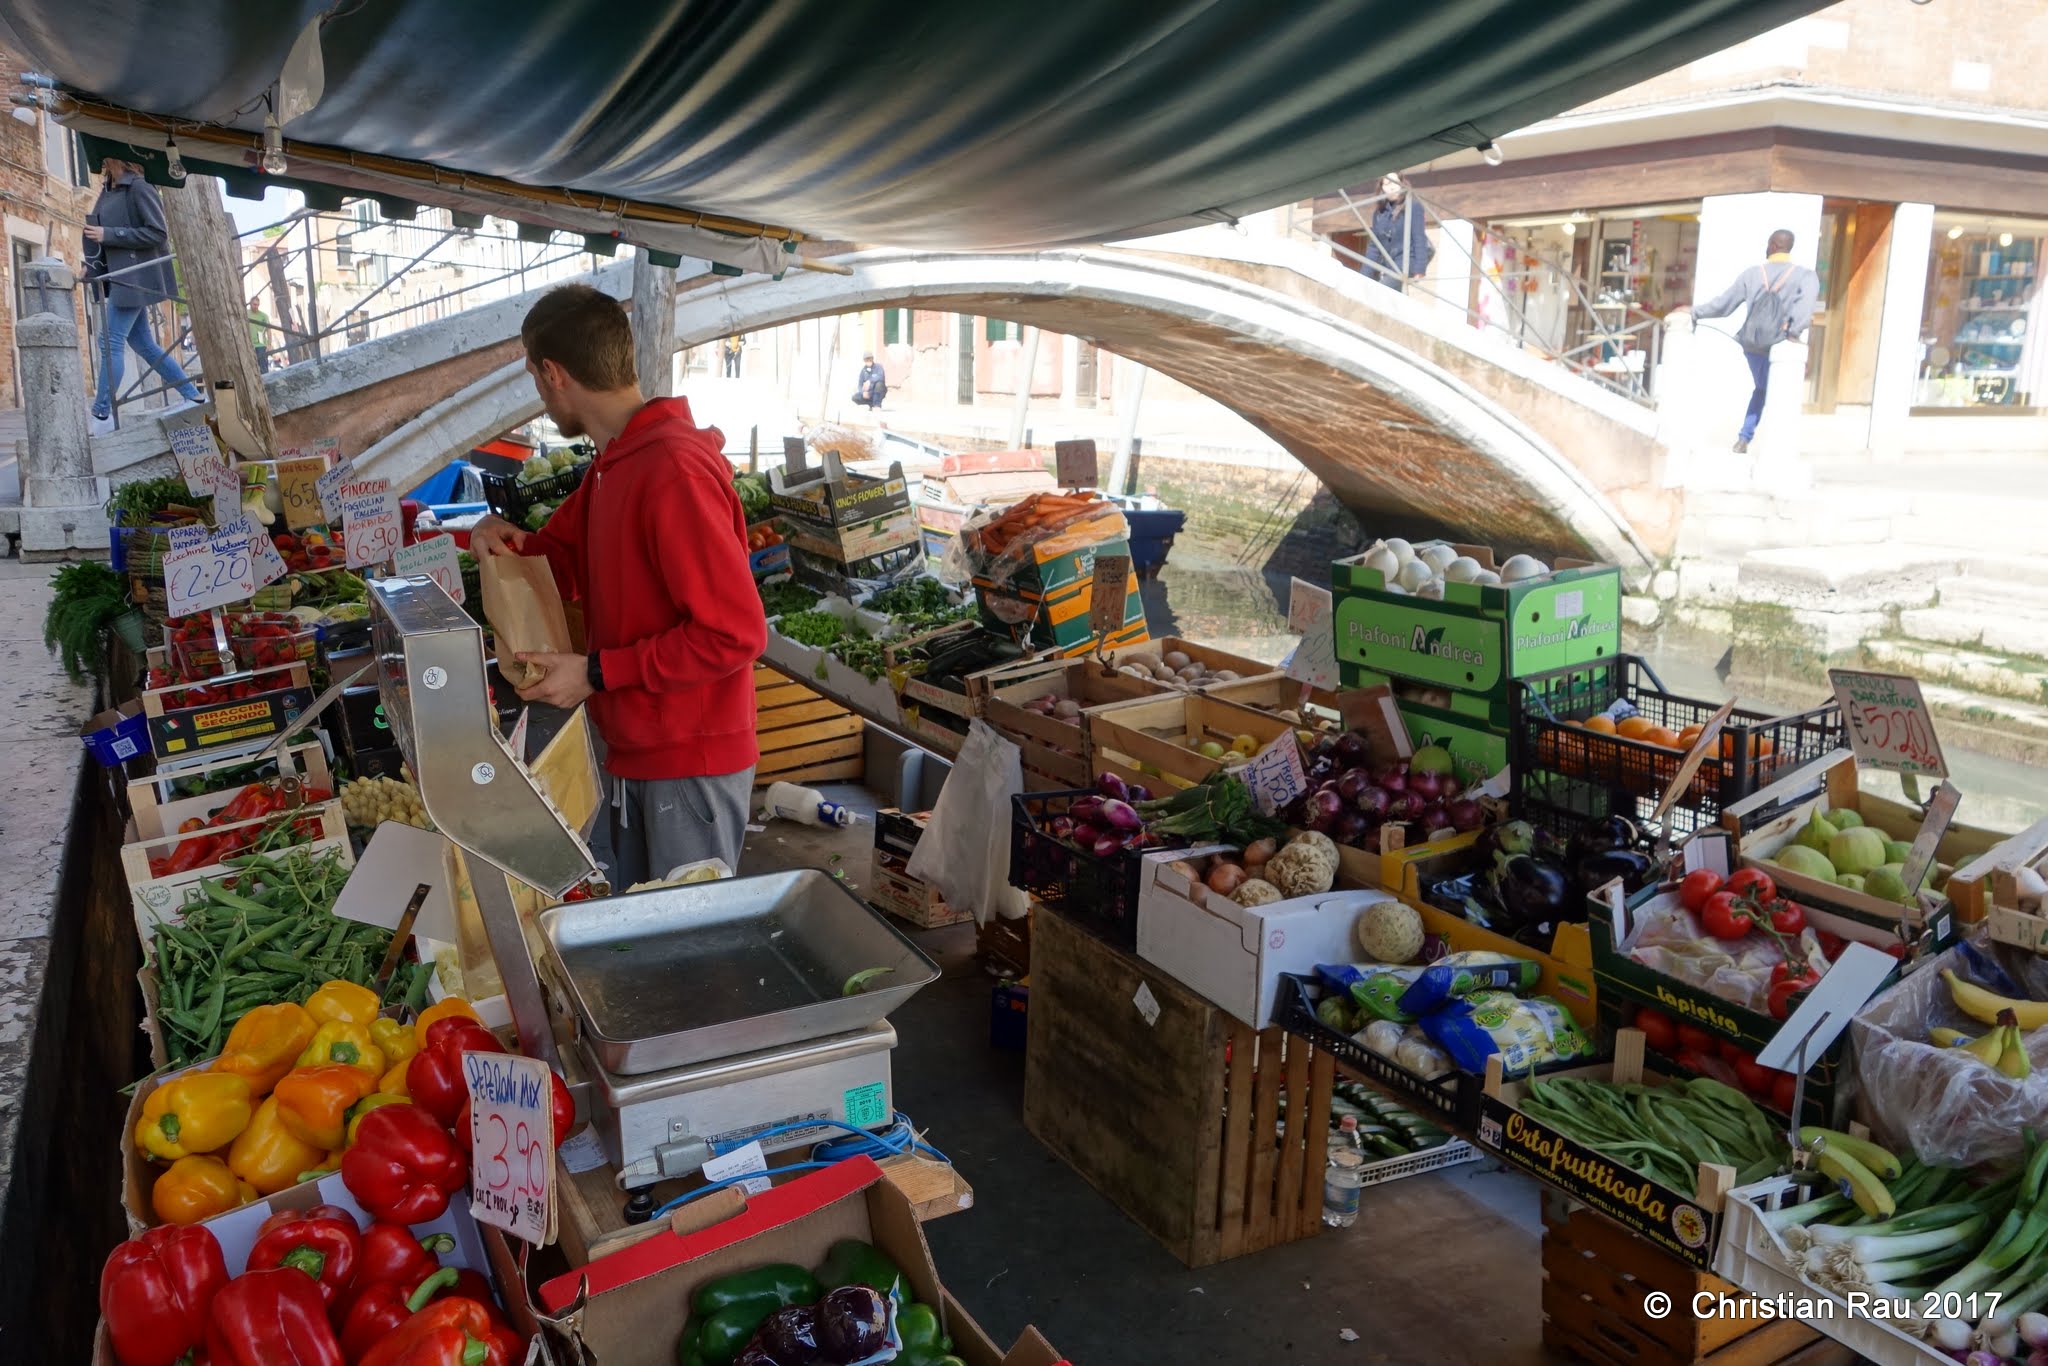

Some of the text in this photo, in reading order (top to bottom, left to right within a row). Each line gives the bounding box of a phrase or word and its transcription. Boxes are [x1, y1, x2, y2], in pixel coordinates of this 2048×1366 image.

[340, 481, 388, 499] FINOCCHI
[857, 484, 886, 503] FLOWERS
[1348, 620, 1407, 650] Plafoni
[1409, 624, 1485, 667] Andrea
[1516, 614, 1619, 651] Plafoni Andrea
[194, 702, 268, 723] PIRACCINI
[200, 710, 267, 729] SECONDO
[1849, 699, 1869, 745] €
[519, 1072, 542, 1110] MIX
[488, 1113, 545, 1206] 3,90
[1506, 1112, 1667, 1224] Ortofrutticola
[1535, 1164, 1563, 1185] GIUSEPPE
[1585, 1192, 1617, 1216] PORTELLA
[1682, 1249, 1697, 1264] (PA)
